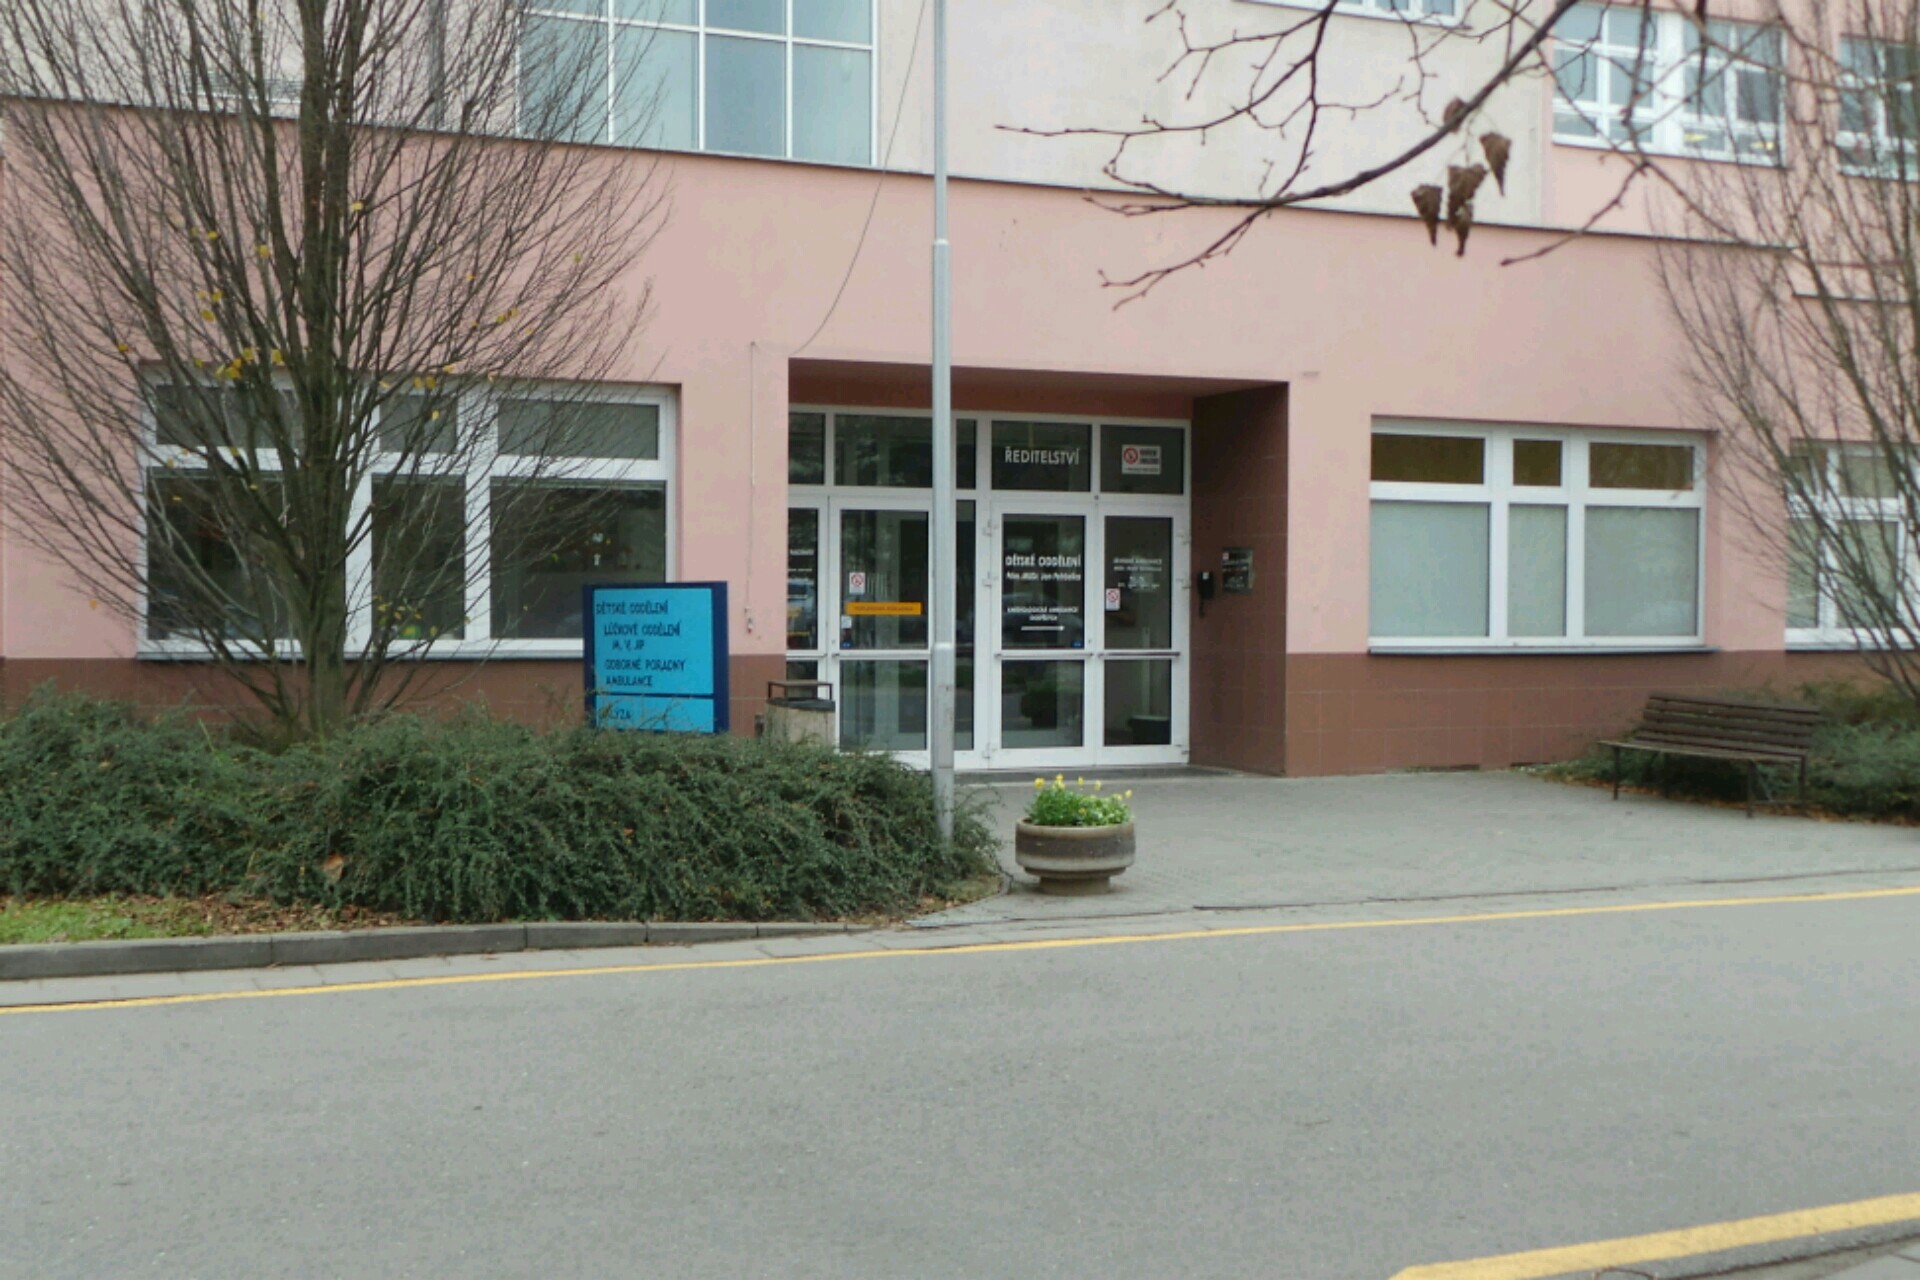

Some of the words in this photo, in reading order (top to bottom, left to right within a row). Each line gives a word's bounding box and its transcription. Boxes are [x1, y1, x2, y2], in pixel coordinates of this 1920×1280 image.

[1004, 446, 1079, 465] ŘEDITELSTVÍ
[1005, 553, 1035, 567] DĚTSKÉ
[1038, 554, 1081, 568] ODDĚLENÍ
[596, 600, 626, 615] DĚTSKÉ
[630, 599, 669, 615] ODDĚLENÍ
[641, 620, 681, 637] ODDĚLENÍ
[645, 658, 686, 672] PORADNY
[606, 675, 653, 687] AMBULANCE
